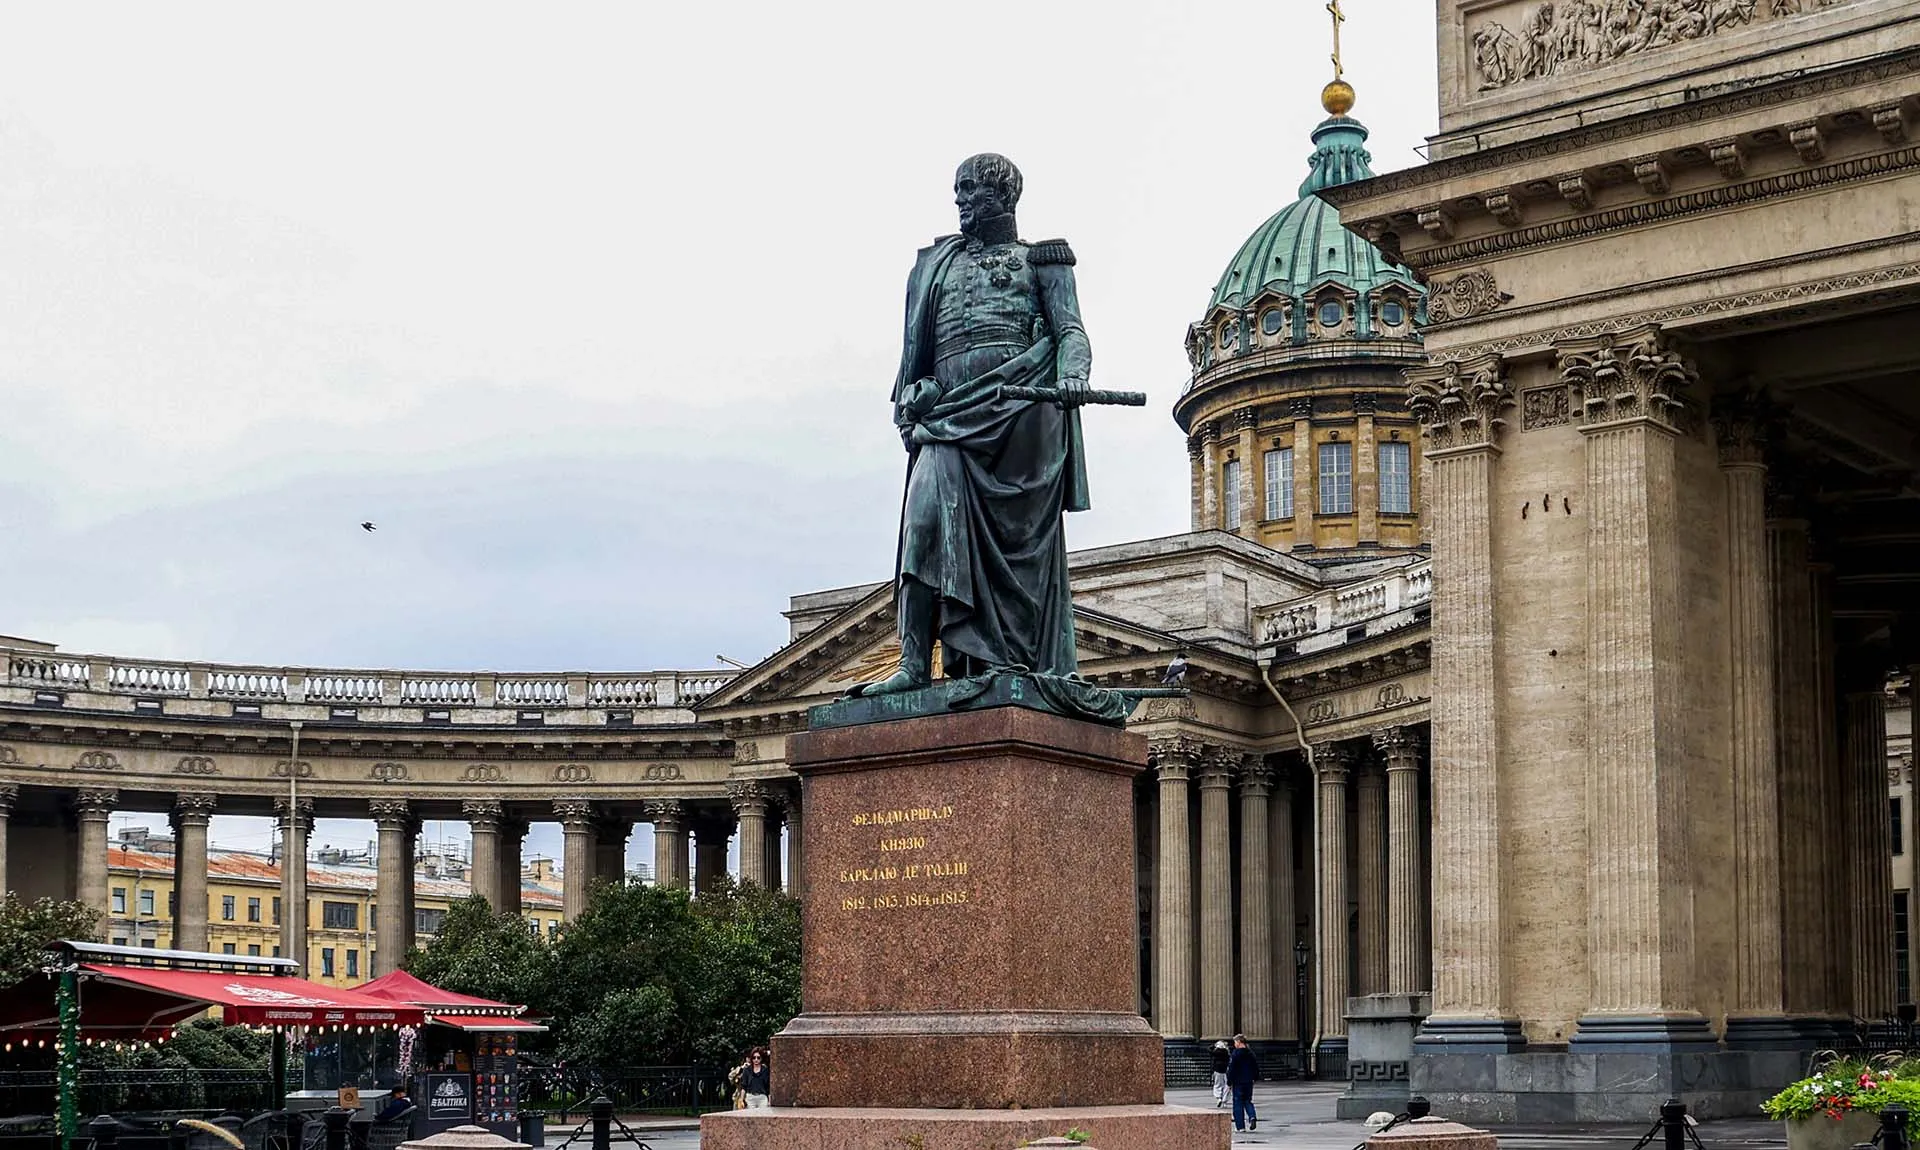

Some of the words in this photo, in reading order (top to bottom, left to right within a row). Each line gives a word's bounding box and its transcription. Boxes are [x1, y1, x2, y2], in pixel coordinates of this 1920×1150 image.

[852, 805, 953, 827] ФЕЛЬДМАРШАЛУ
[880, 836, 925, 852] КНЯЗЮ
[840, 867, 897, 884] БАРКЛАЮ
[902, 865, 919, 881] ДЕ
[923, 862, 968, 877] ТОЛЛИ
